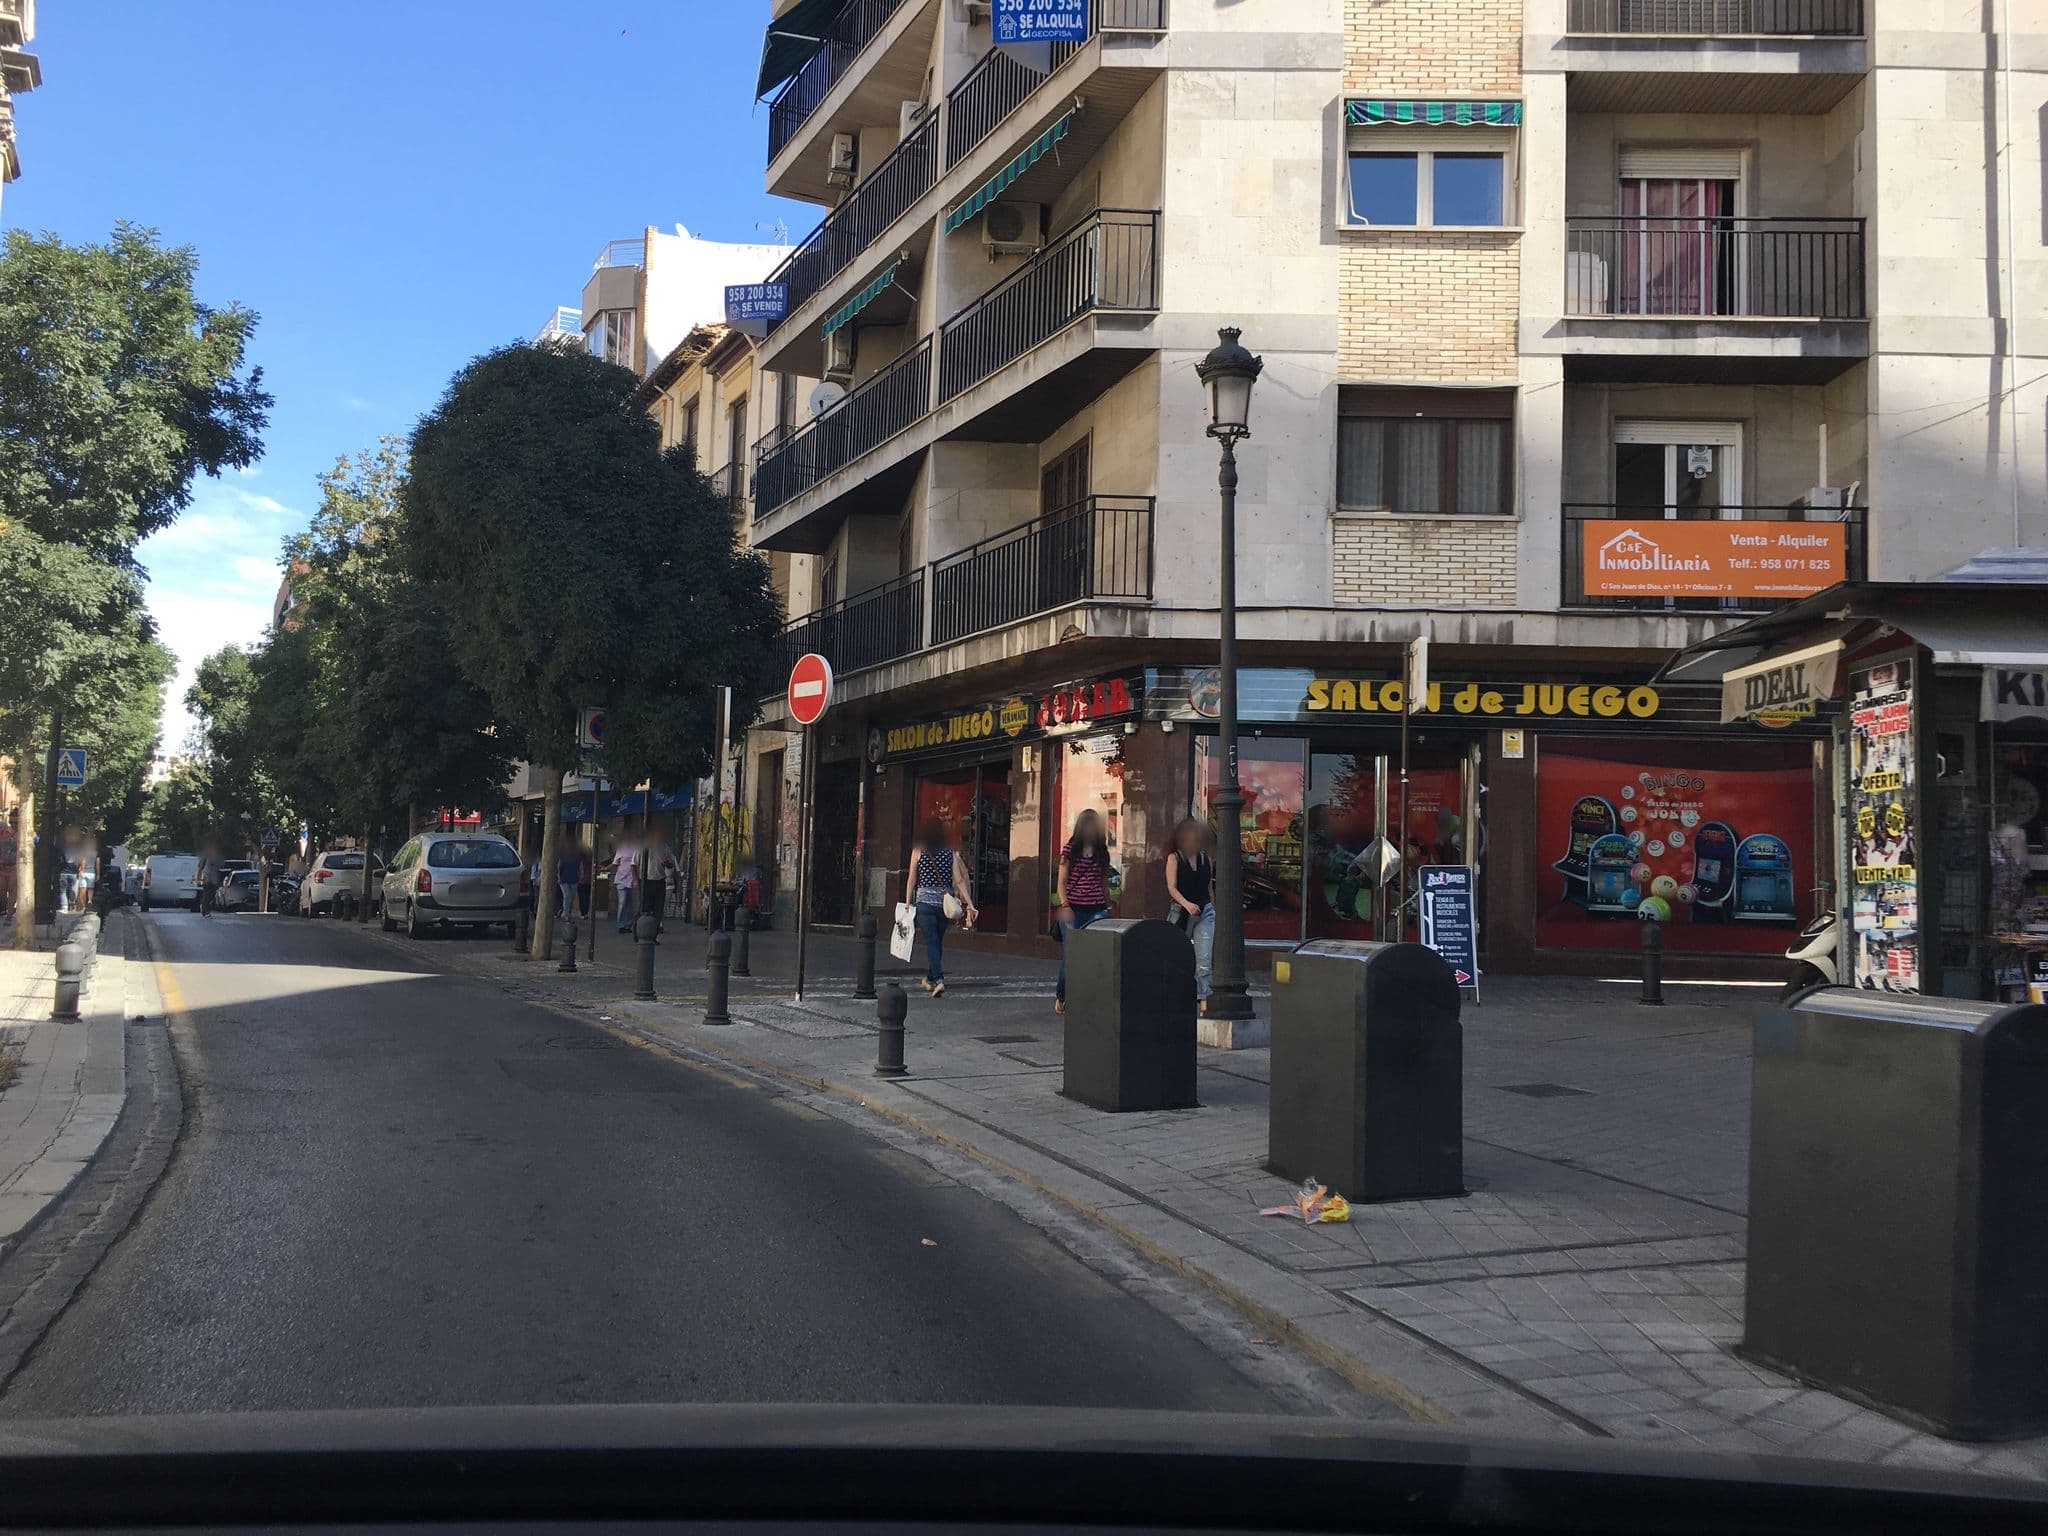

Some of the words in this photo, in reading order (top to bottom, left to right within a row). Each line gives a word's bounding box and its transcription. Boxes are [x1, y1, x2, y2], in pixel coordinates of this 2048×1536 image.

[1020, 14, 1033, 29] SE
[1036, 14, 1083, 29] ALQUILA
[728, 287, 745, 302] 958
[747, 286, 764, 300] 200
[766, 286, 783, 299] 934
[741, 302, 752, 312] SE
[754, 301, 783, 311] VENDE
[1730, 534, 1768, 546] Venta
[1778, 534, 1829, 549] Alquiler
[1760, 559, 1781, 569] 958
[1785, 559, 1805, 569] 071
[1809, 559, 1831, 570] 825
[1745, 663, 1810, 711] IDEAL
[1453, 684, 1504, 714] de
[1515, 683, 1660, 717] JUEGO
[887, 722, 926, 752] SALON
[927, 722, 943, 745] de
[945, 710, 993, 742] JUEGO
[1880, 717, 1909, 733] DIOS
[1644, 773, 1706, 792] BINGO
[1863, 773, 1901, 790] OFERTA
